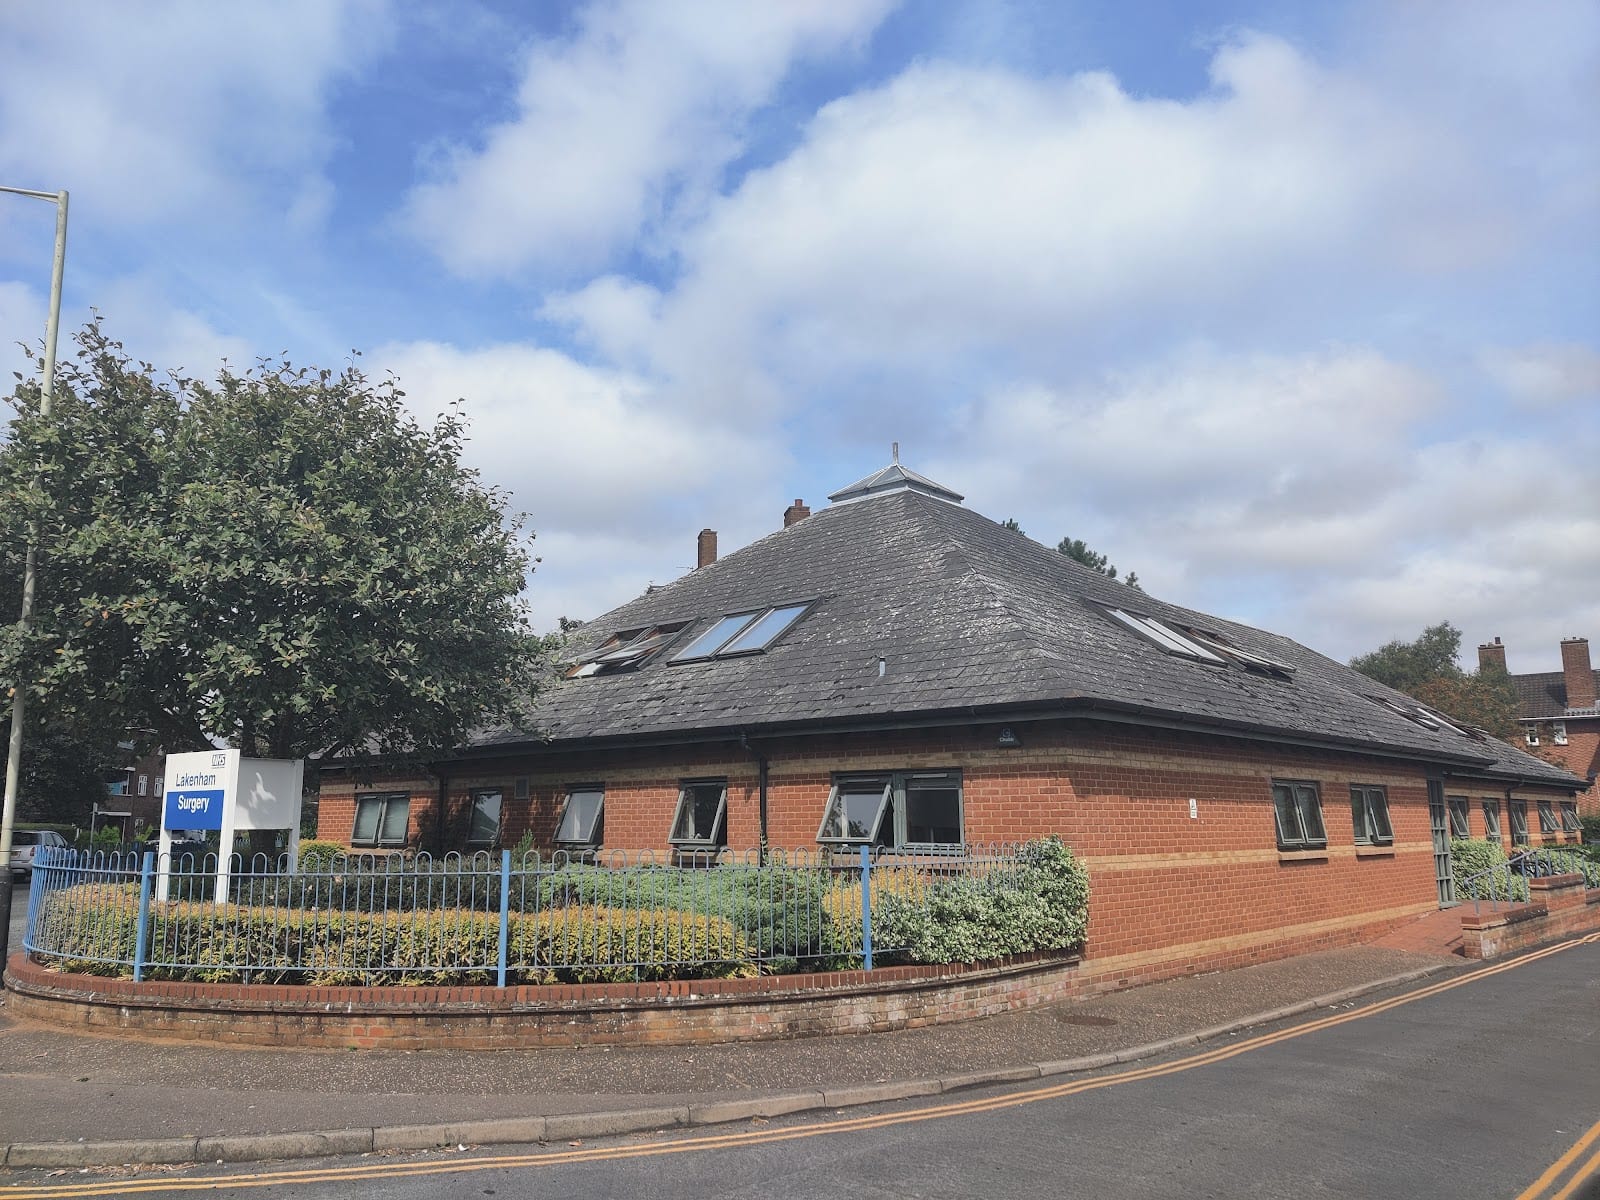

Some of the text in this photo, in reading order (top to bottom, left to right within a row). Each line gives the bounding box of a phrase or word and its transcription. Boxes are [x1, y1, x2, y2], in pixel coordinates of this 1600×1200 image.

[212, 755, 225, 766] NHS
[176, 772, 216, 787] Lakenham
[178, 794, 210, 813] Surgery
